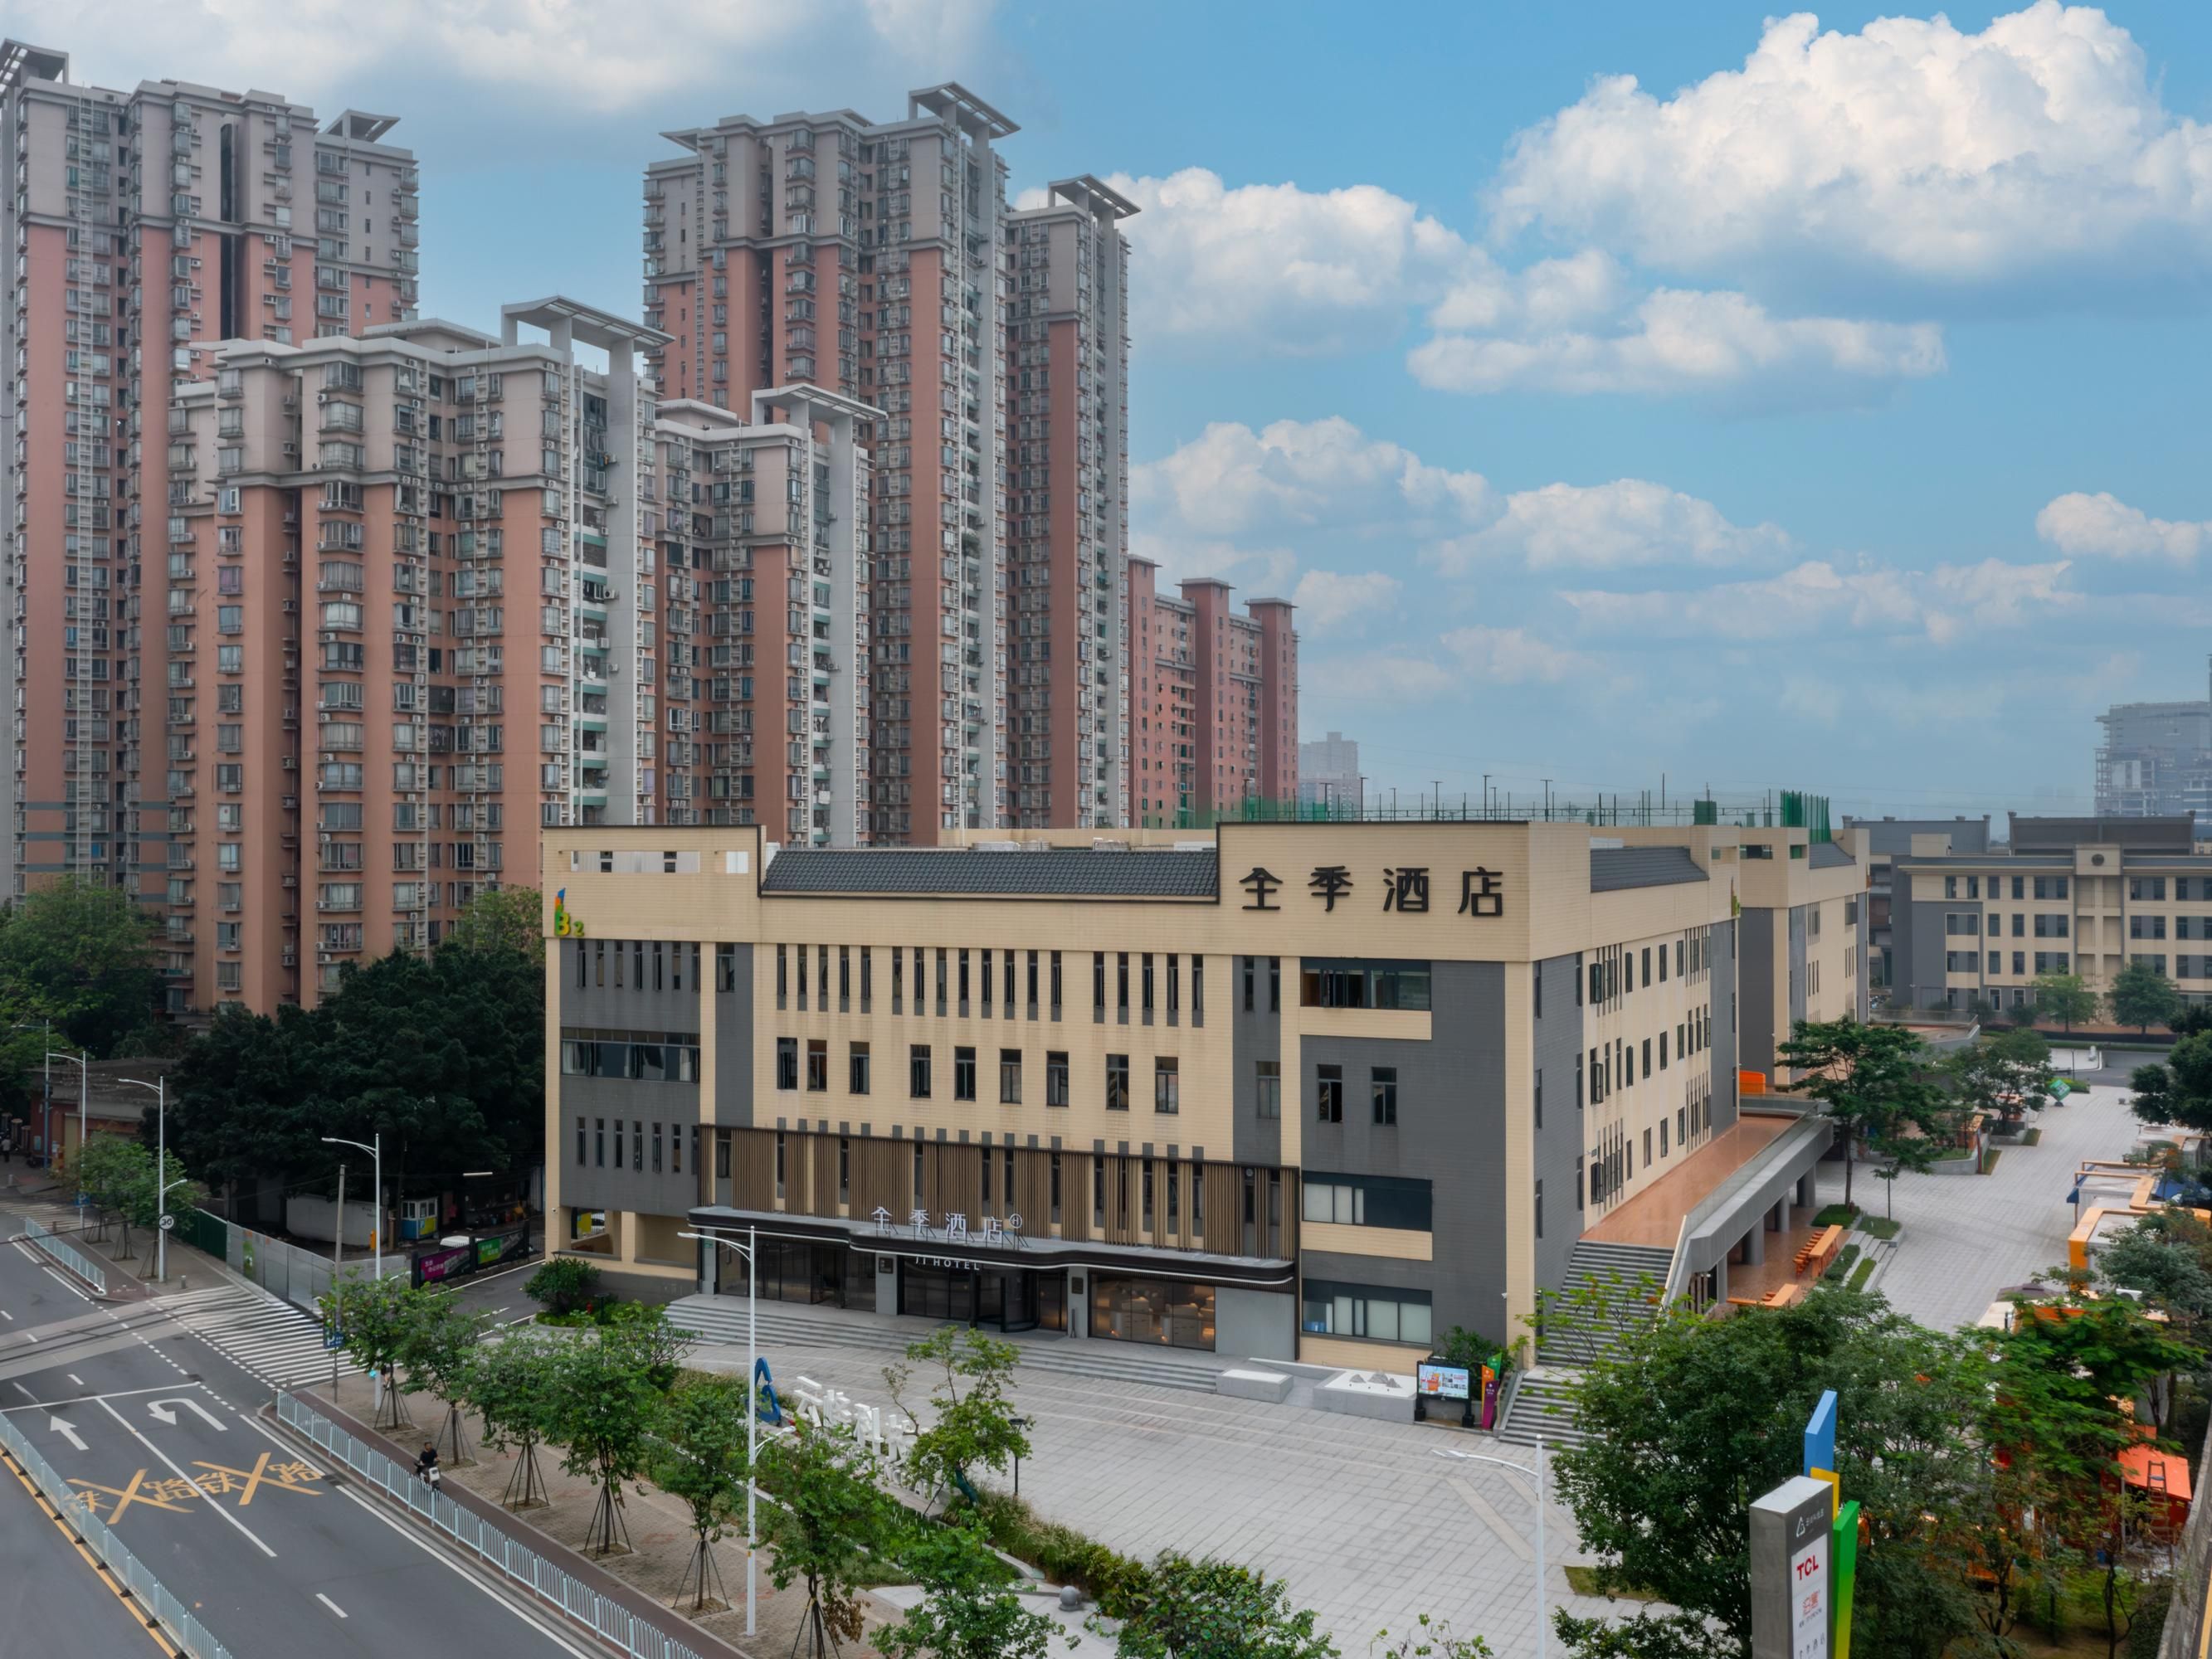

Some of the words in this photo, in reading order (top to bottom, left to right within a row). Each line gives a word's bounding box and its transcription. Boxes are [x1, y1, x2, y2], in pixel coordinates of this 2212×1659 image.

[1239, 865, 1503, 917] 全季酒店
[161, 1218, 173, 1226] 30
[871, 1206, 1002, 1243] 全季酒店
[933, 1259, 981, 1271] HOTEL
[1796, 1554, 1820, 1581] TCL
